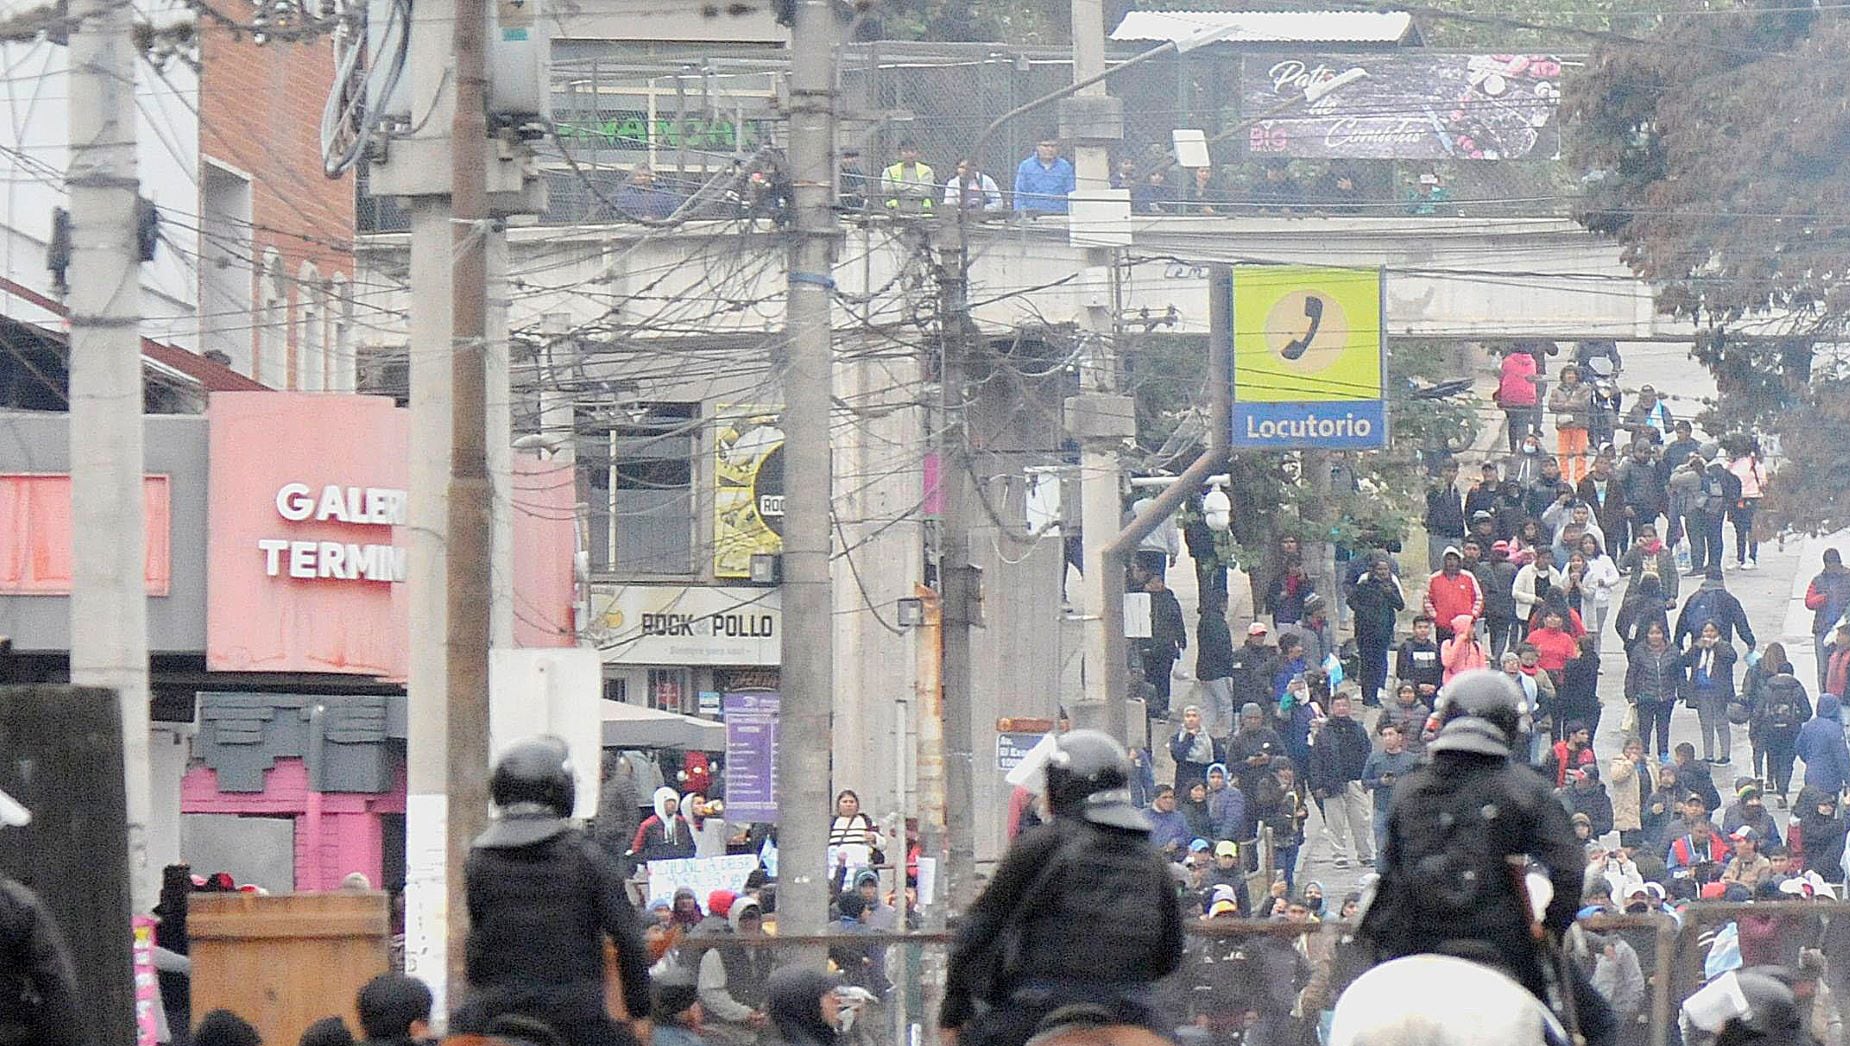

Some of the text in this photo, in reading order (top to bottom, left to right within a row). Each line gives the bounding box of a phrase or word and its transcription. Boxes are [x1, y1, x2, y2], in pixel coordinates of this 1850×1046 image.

[1246, 412, 1371, 438] Locutorio
[641, 613, 694, 637] ROCK
[712, 613, 773, 637] POLLO
